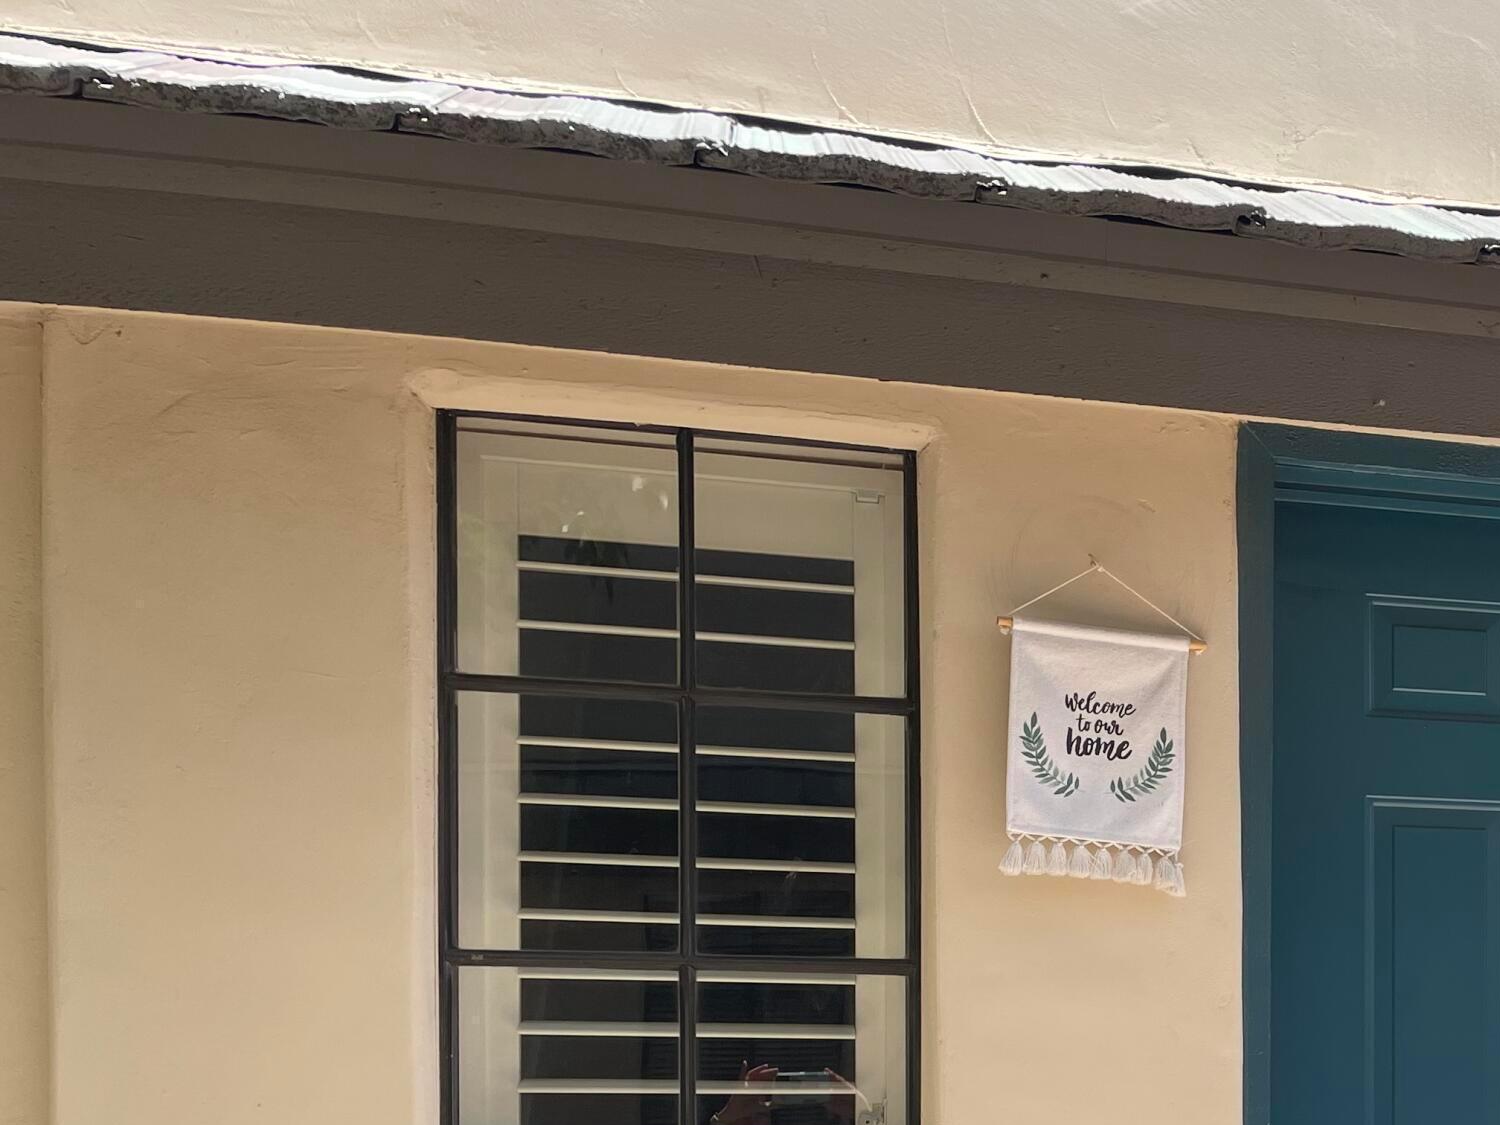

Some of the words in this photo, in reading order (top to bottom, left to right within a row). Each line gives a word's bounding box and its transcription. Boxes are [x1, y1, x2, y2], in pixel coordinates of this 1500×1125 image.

[1076, 714, 1091, 732] to
[1094, 719, 1124, 736] our
[1066, 727, 1132, 761] home
